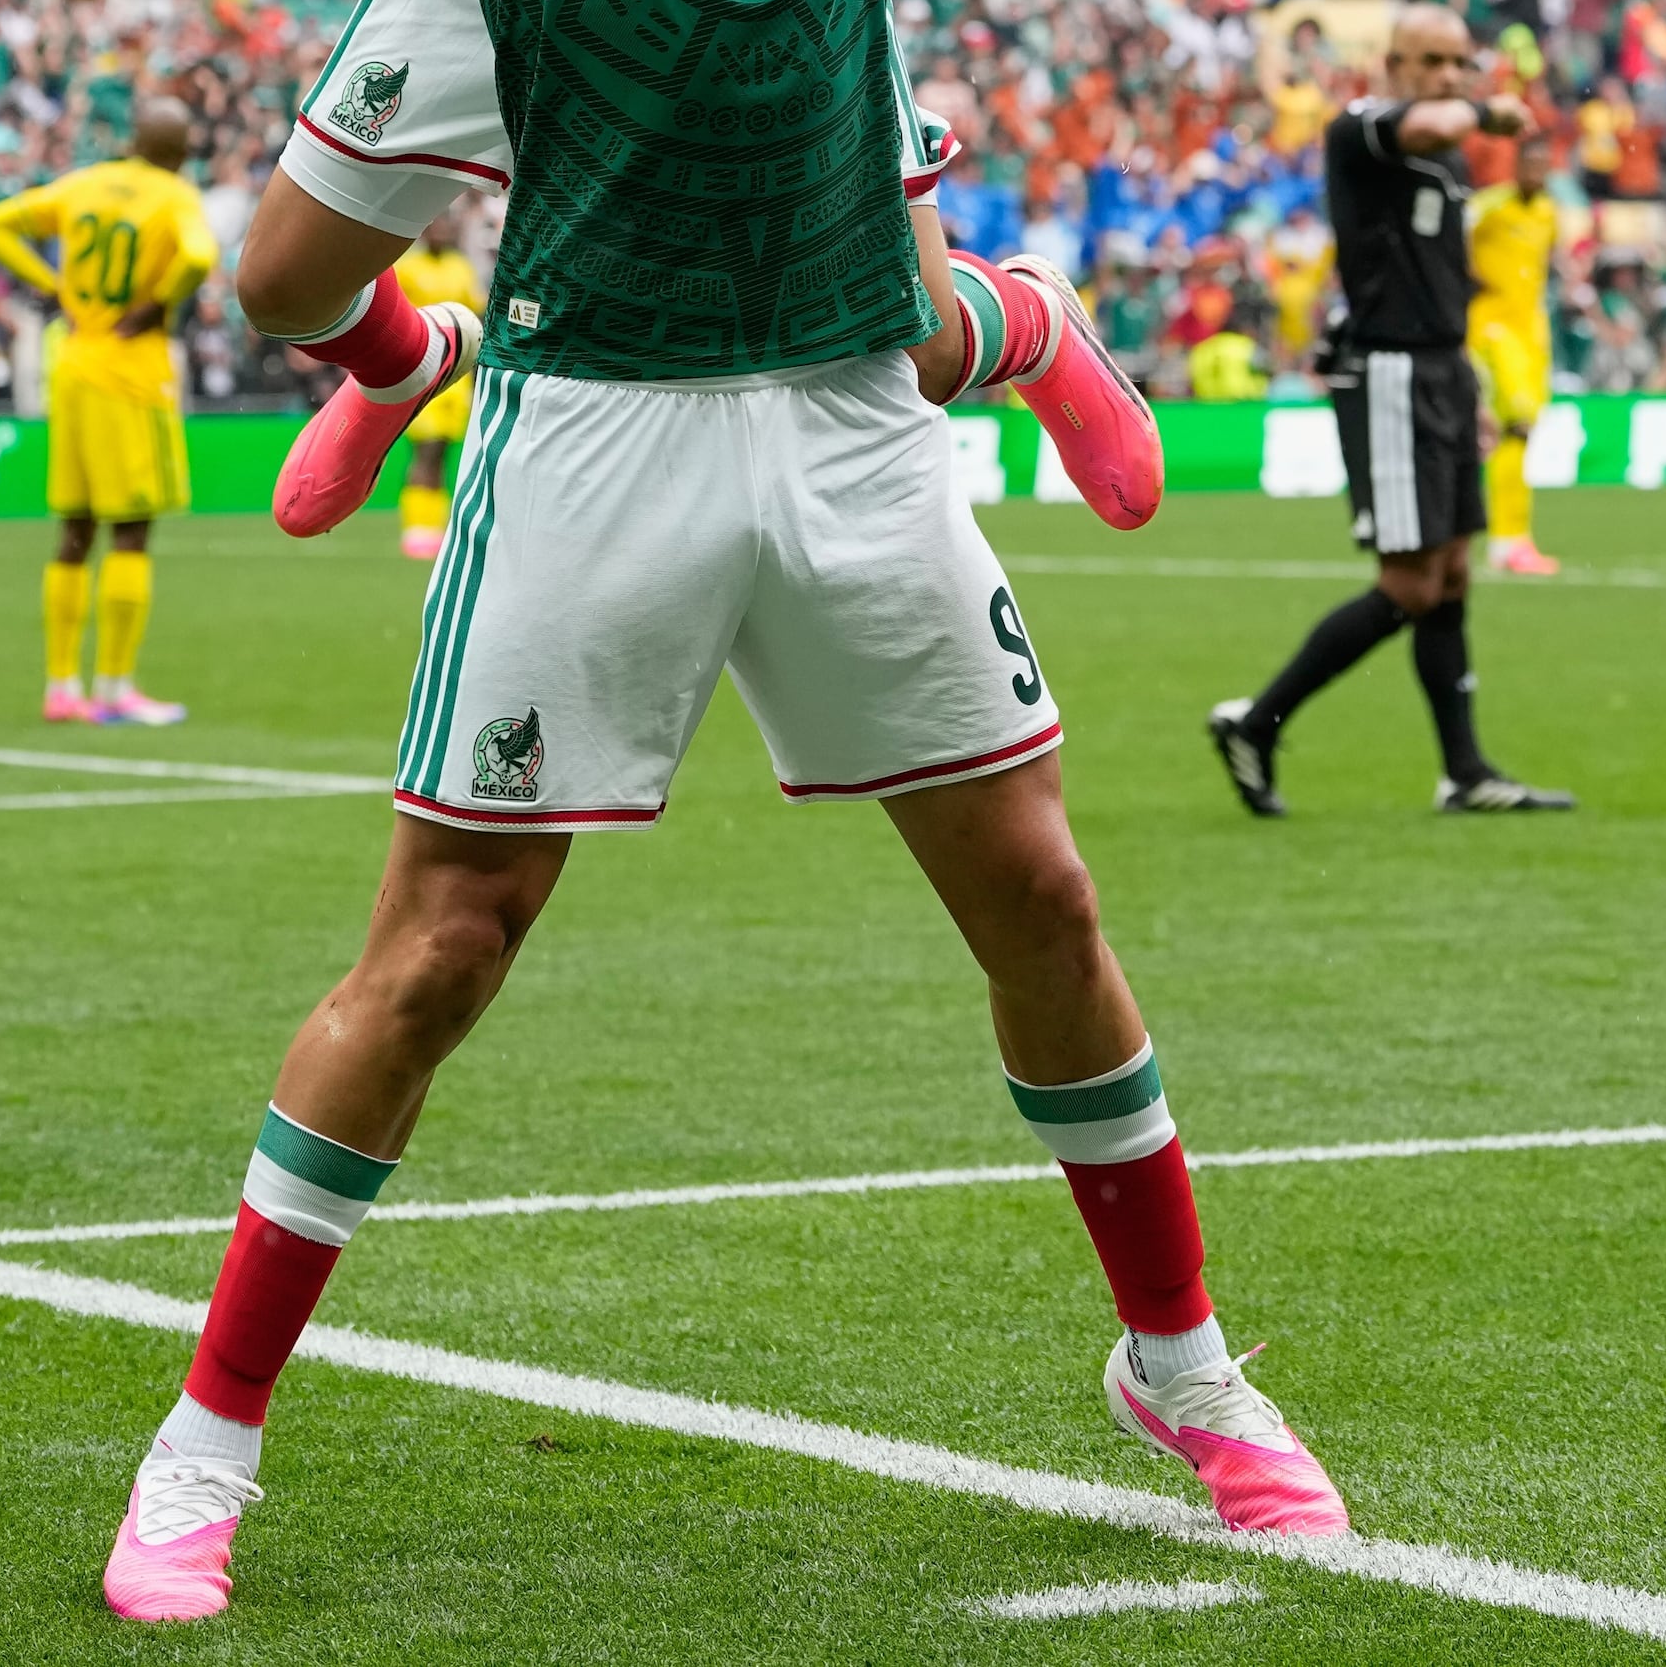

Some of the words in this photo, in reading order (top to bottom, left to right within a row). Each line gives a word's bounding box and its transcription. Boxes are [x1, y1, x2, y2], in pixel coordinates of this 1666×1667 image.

[331, 108, 378, 142] MÉXICO
[74, 212, 138, 304] 20
[989, 585, 1042, 706] 9
[475, 781, 534, 798] MÉXICO
